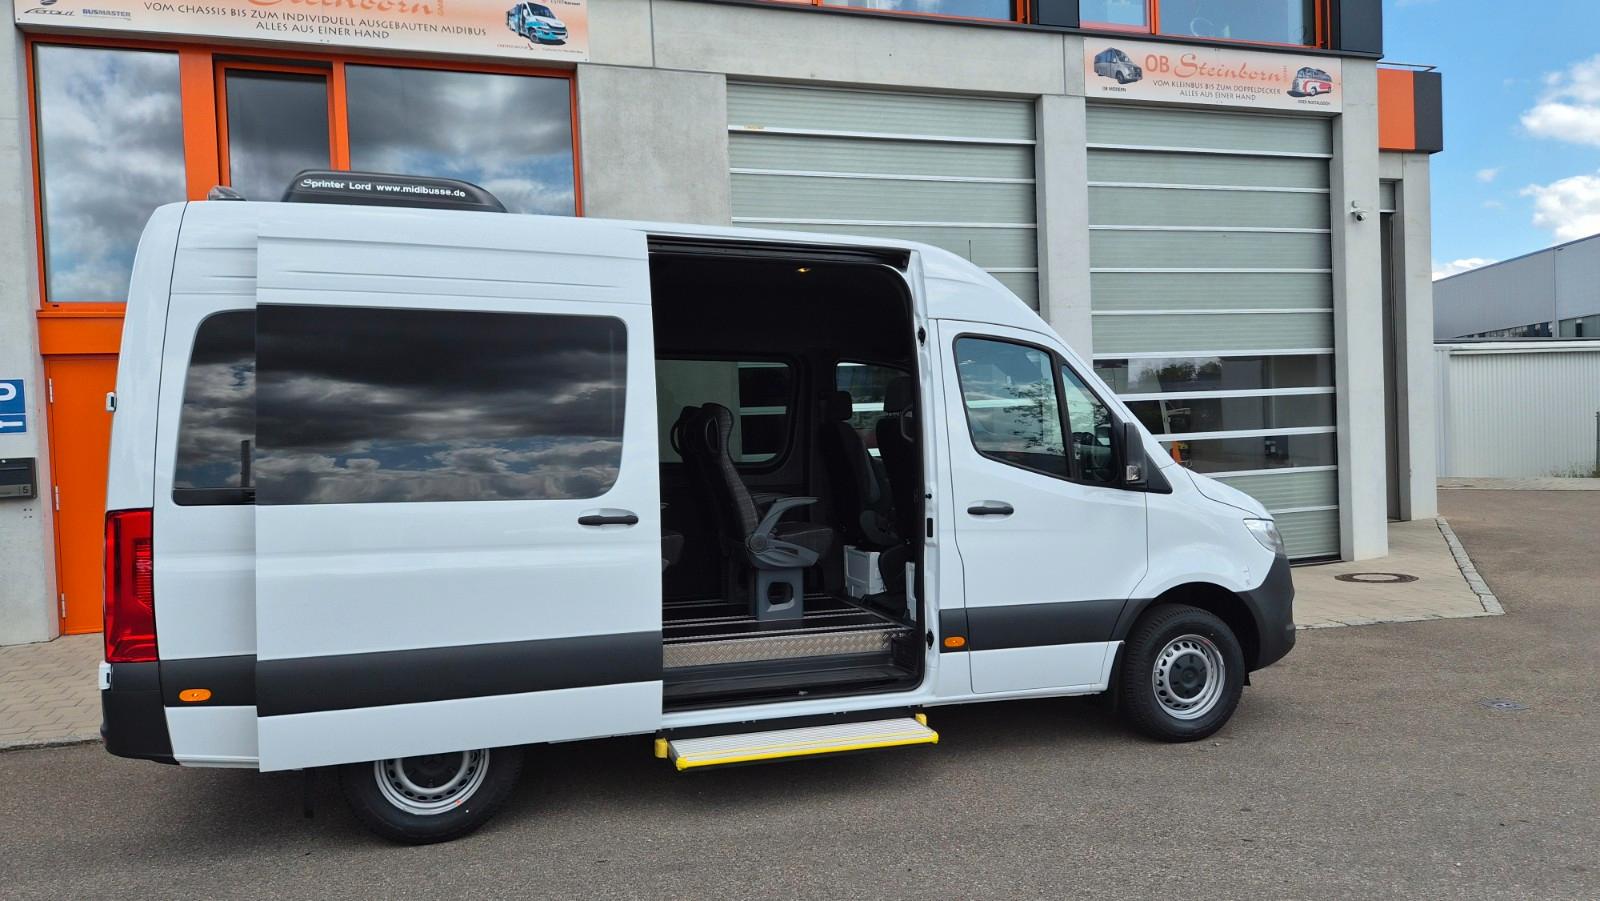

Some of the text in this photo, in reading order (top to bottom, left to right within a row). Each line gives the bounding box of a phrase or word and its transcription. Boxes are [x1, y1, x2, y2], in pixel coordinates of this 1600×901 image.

[144, 2, 487, 36] VOM CHASSIS BIS ZUM INDIVIDUELL AUSGEBAUTEN MIDIBUS
[256, 22, 390, 39] ALLES AUS EINER HAND
[1145, 54, 1170, 73] OB
[1174, 53, 1280, 82] Steinborn
[1171, 81, 1203, 90] KLEINBUS
[1216, 83, 1232, 92] ZUM
[1233, 85, 1281, 95] DOPPELDECKER
[1215, 92, 1234, 100] EINER
[301, 178, 466, 198] Sprinter Lord www.midibusse.de
